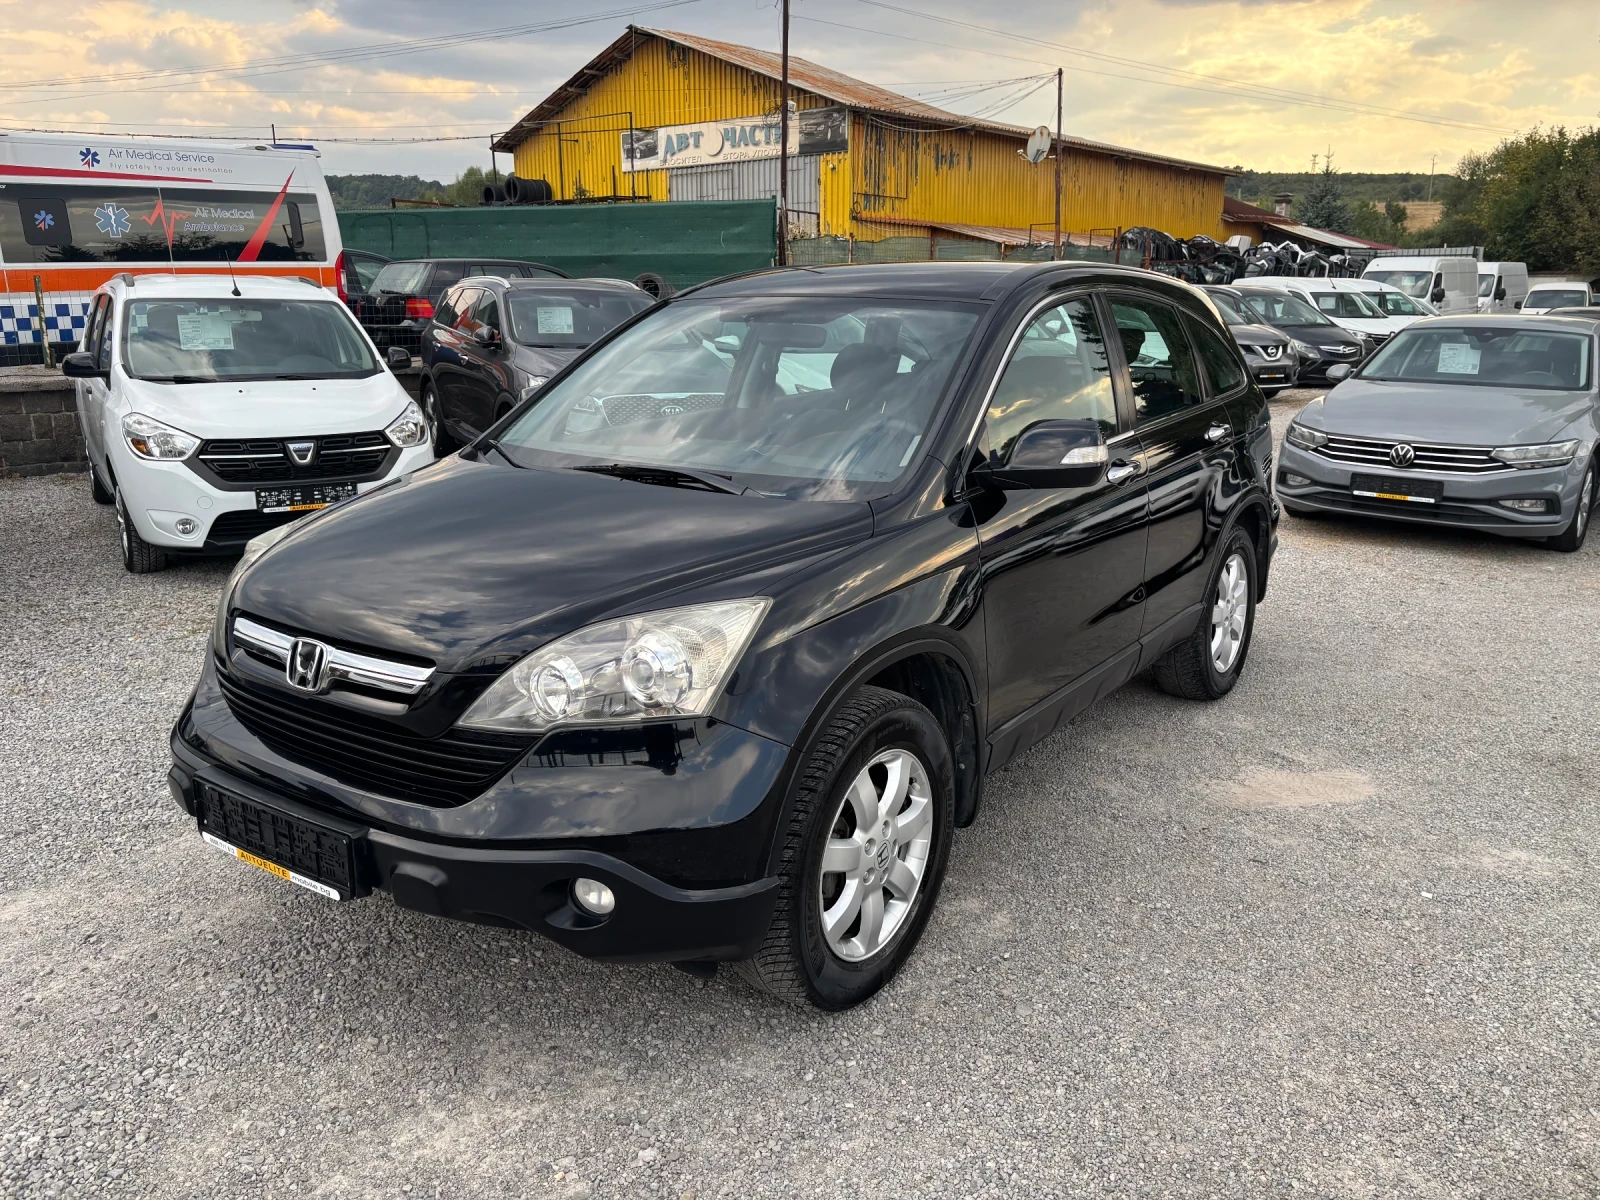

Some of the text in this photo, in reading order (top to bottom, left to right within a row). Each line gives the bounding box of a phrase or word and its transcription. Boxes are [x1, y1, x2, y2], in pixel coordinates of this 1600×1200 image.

[108, 148, 215, 163] Air Medical Service
[752, 146, 798, 158] УПОТРБА
[125, 163, 151, 171] safely
[187, 166, 233, 174] destination
[194, 207, 255, 219] Air Medical
[184, 221, 245, 232] Ambulance
[240, 851, 288, 878] AUTOELITE
